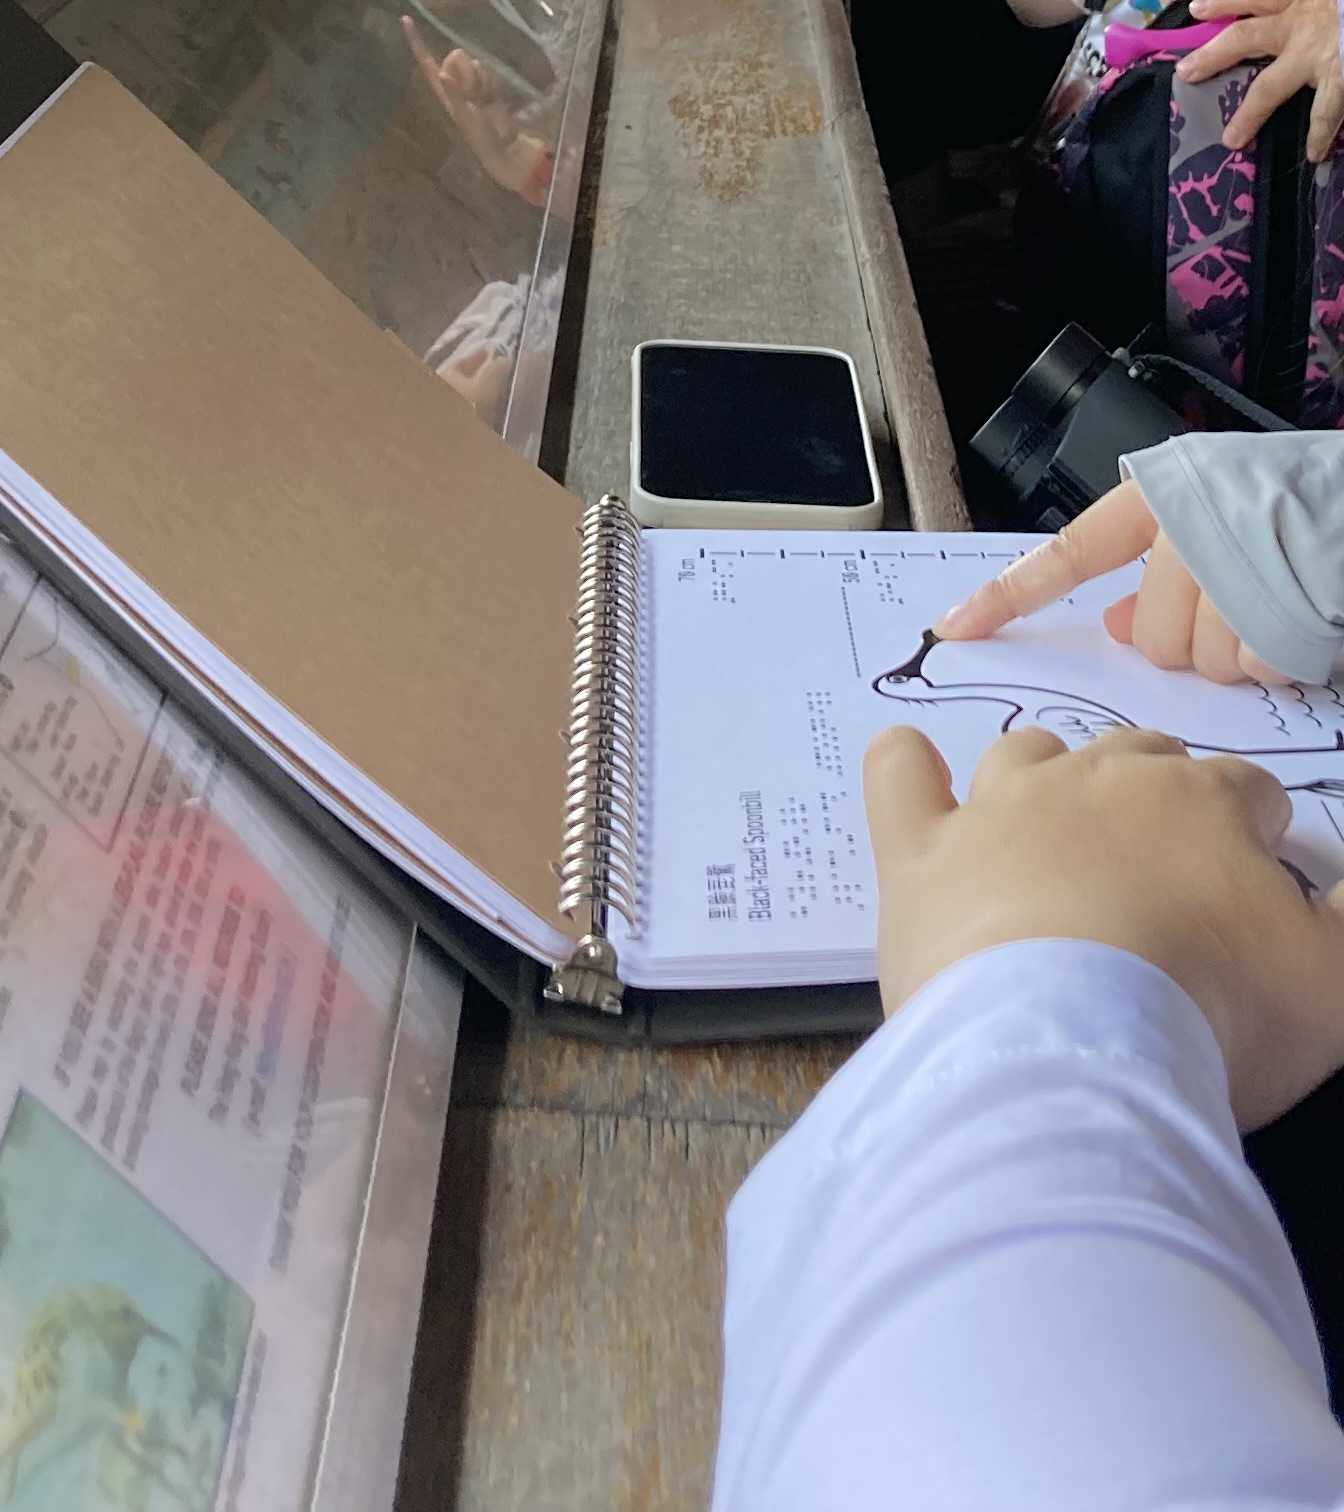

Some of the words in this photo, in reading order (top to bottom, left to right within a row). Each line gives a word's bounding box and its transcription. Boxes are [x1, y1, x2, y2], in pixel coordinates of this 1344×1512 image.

[682, 558, 695, 570] cm
[844, 559, 858, 571] cm
[678, 571, 695, 582] 70
[738, 790, 770, 845] Spoonbill
[743, 846, 772, 921] Black-faced
